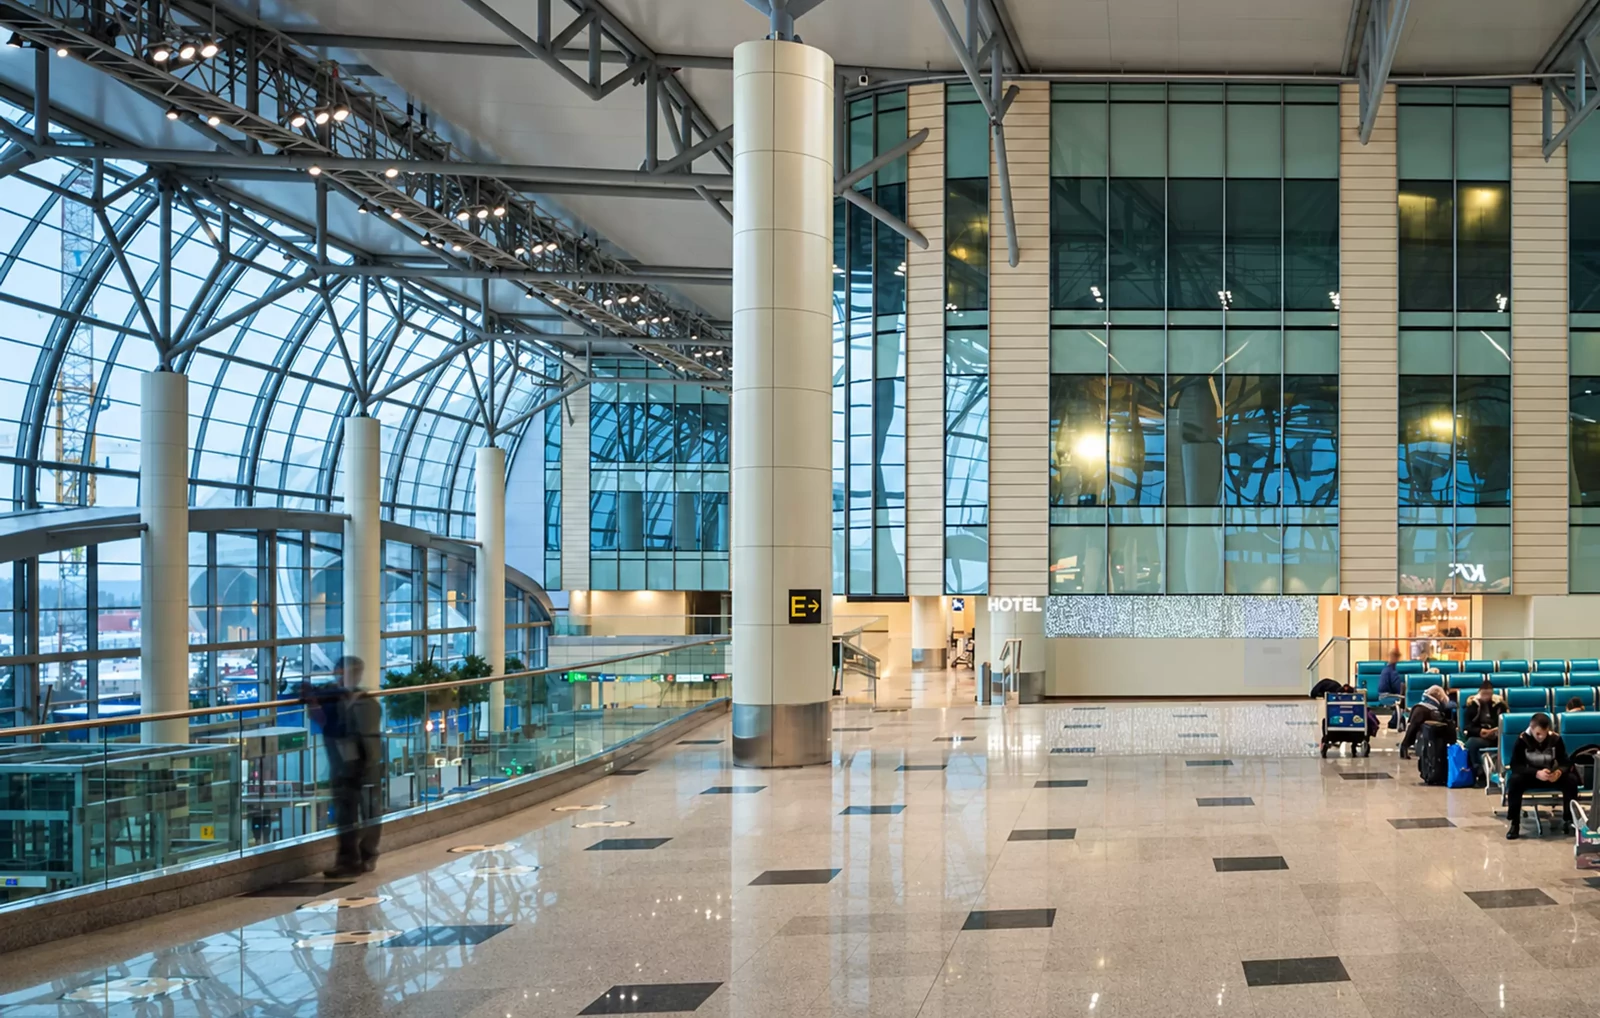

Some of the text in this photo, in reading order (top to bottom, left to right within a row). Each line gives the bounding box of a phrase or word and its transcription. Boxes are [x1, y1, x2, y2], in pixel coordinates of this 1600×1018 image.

[791, 596, 806, 617] E
[988, 597, 1042, 612] HOTEL
[1338, 597, 1459, 611] АЭРОТЕЛЬ
